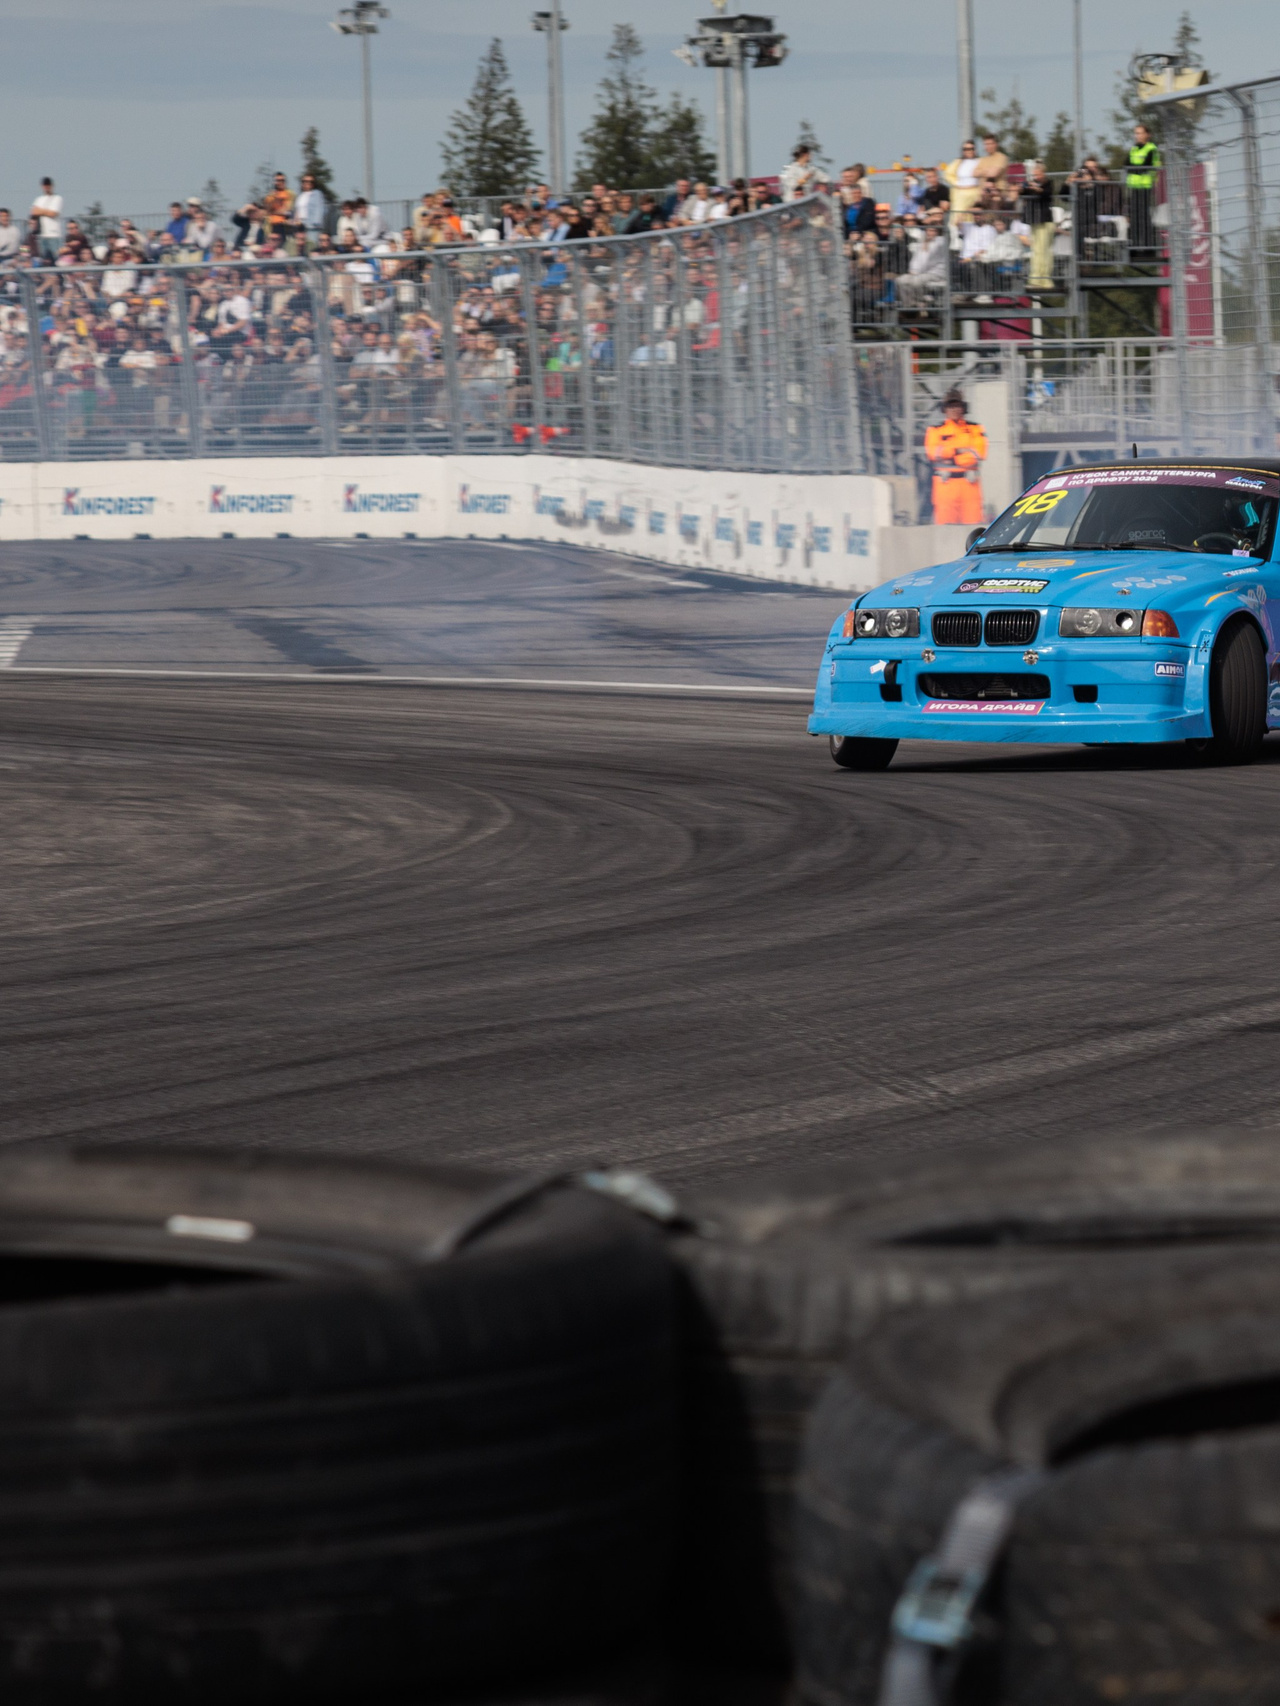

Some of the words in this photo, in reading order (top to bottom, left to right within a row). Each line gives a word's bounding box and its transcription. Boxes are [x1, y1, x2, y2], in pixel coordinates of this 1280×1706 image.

[1073, 472, 1109, 480] КУБОК
[1111, 470, 1217, 479] САНКТ-ПЕТЕРБУРГА
[1085, 476, 1132, 485] ДРИФТУ
[1013, 490, 1069, 518] 18
[983, 578, 1048, 588] ФОРТИС
[929, 702, 979, 712] ИГОРА
[981, 701, 1037, 713] ДРАЙВ
